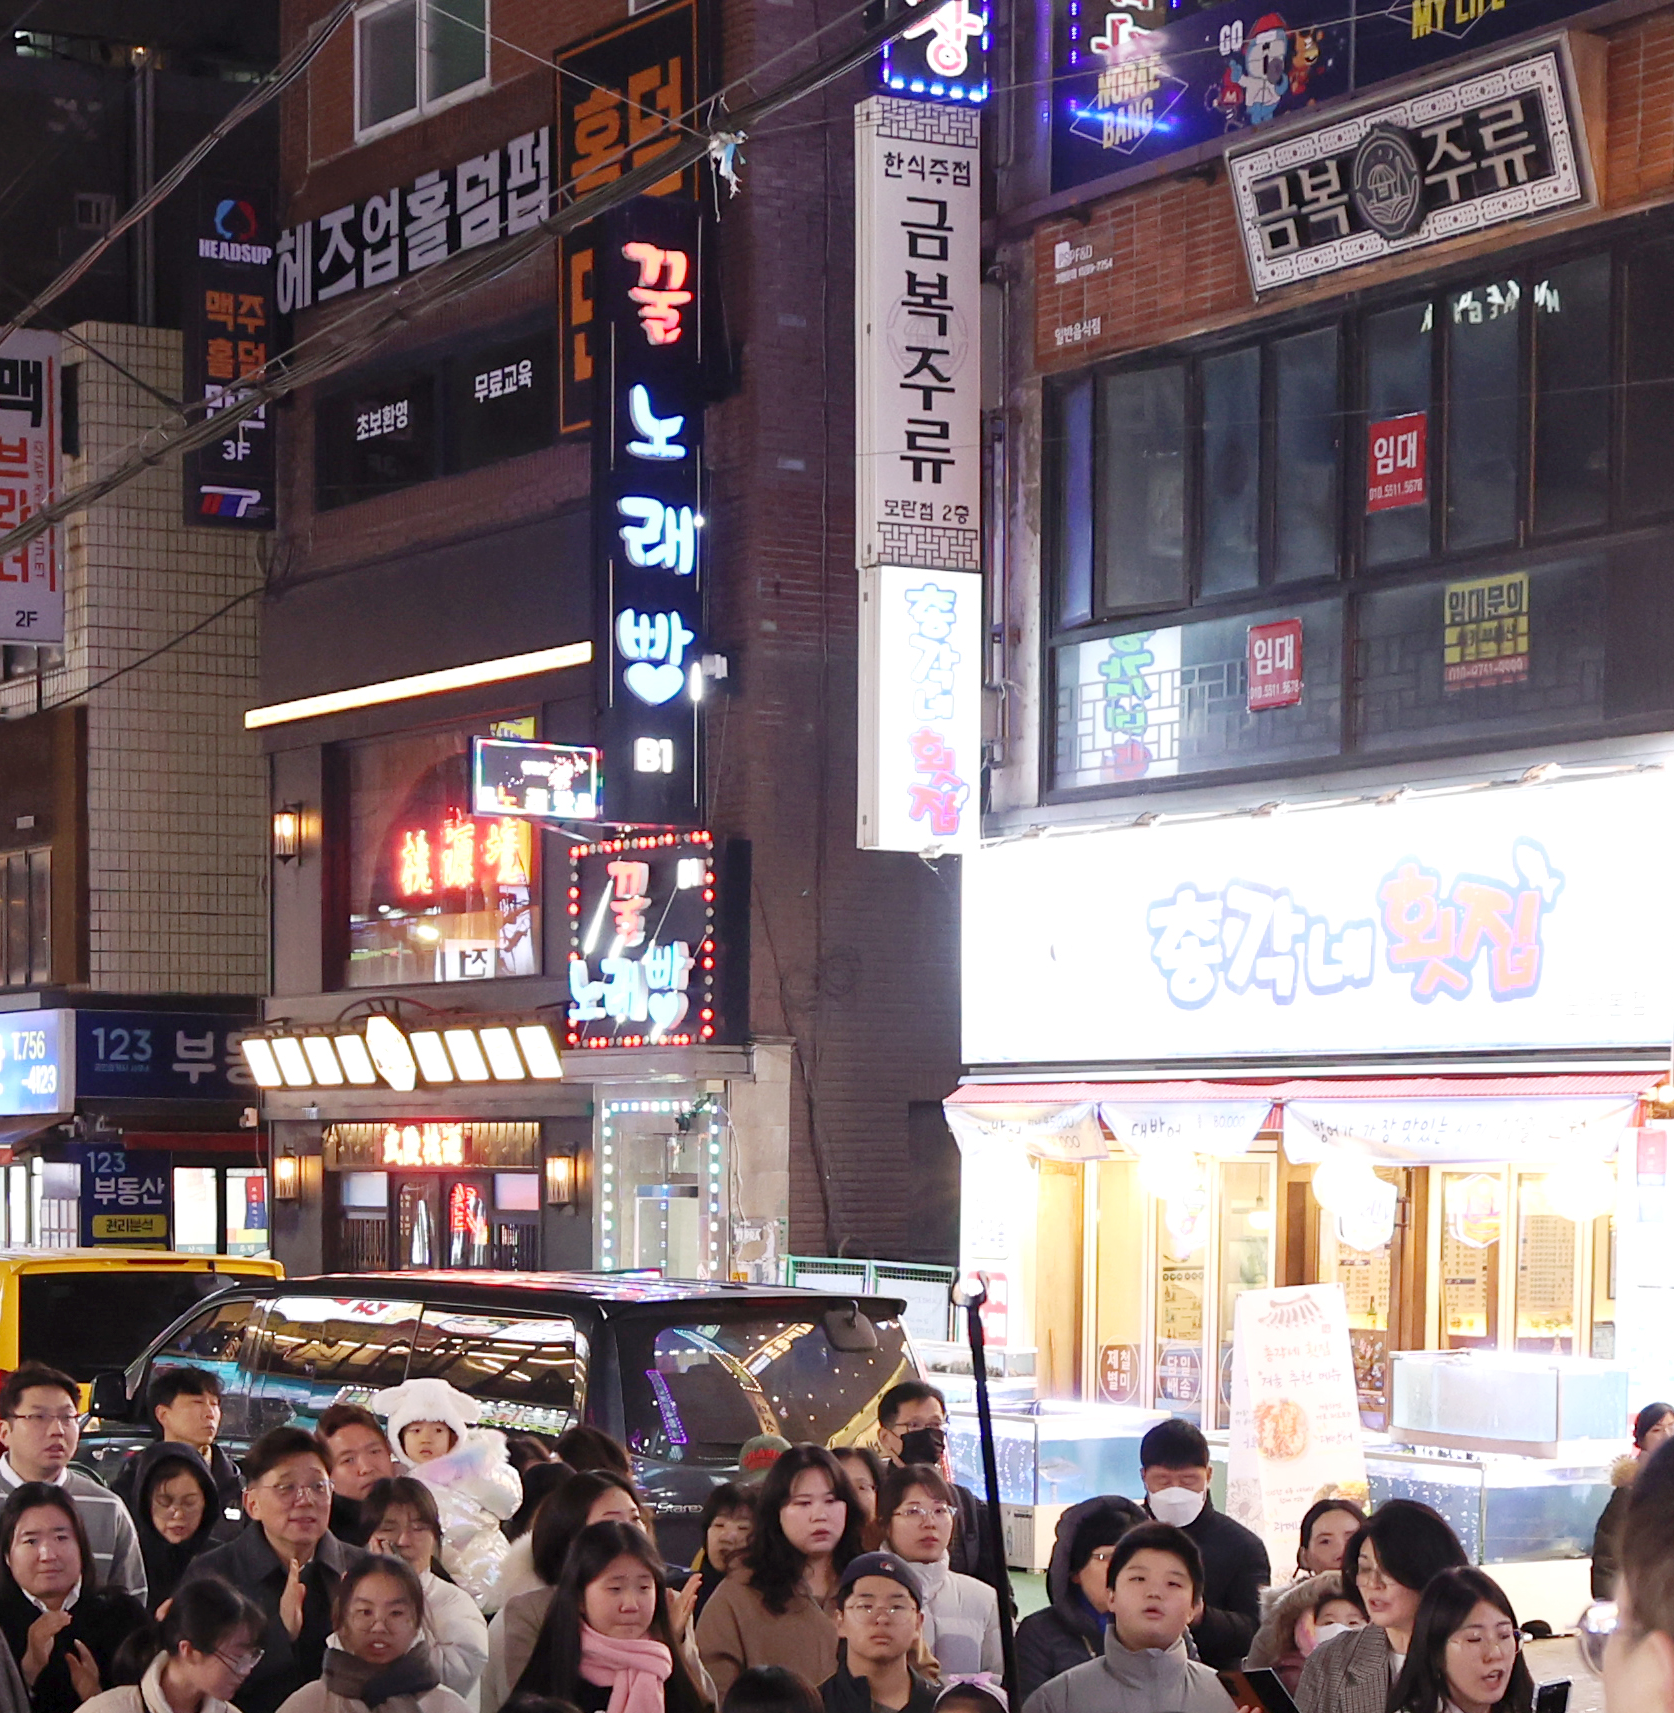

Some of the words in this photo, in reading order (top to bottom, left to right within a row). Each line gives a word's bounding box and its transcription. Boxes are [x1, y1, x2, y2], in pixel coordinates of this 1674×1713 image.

[1219, 20, 1244, 56] GO
[1249, 160, 1352, 260] 금복
[1421, 100, 1537, 200] 주류
[199, 238, 273, 267] HEADSUP
[899, 197, 958, 486] 금복주류
[221, 441, 251, 460] 3F
[1373, 430, 1418, 476] 임대
[884, 497, 934, 523] 모란점
[940, 500, 970, 526] 2층
[16, 610, 38, 627] 2F
[1253, 634, 1295, 676] 임대
[633, 737, 674, 775] B1
[1378, 856, 1551, 1004] 횟집
[92, 1027, 154, 1062] 123
[87, 1151, 126, 1174] 123
[94, 1177, 166, 1206] 부동산
